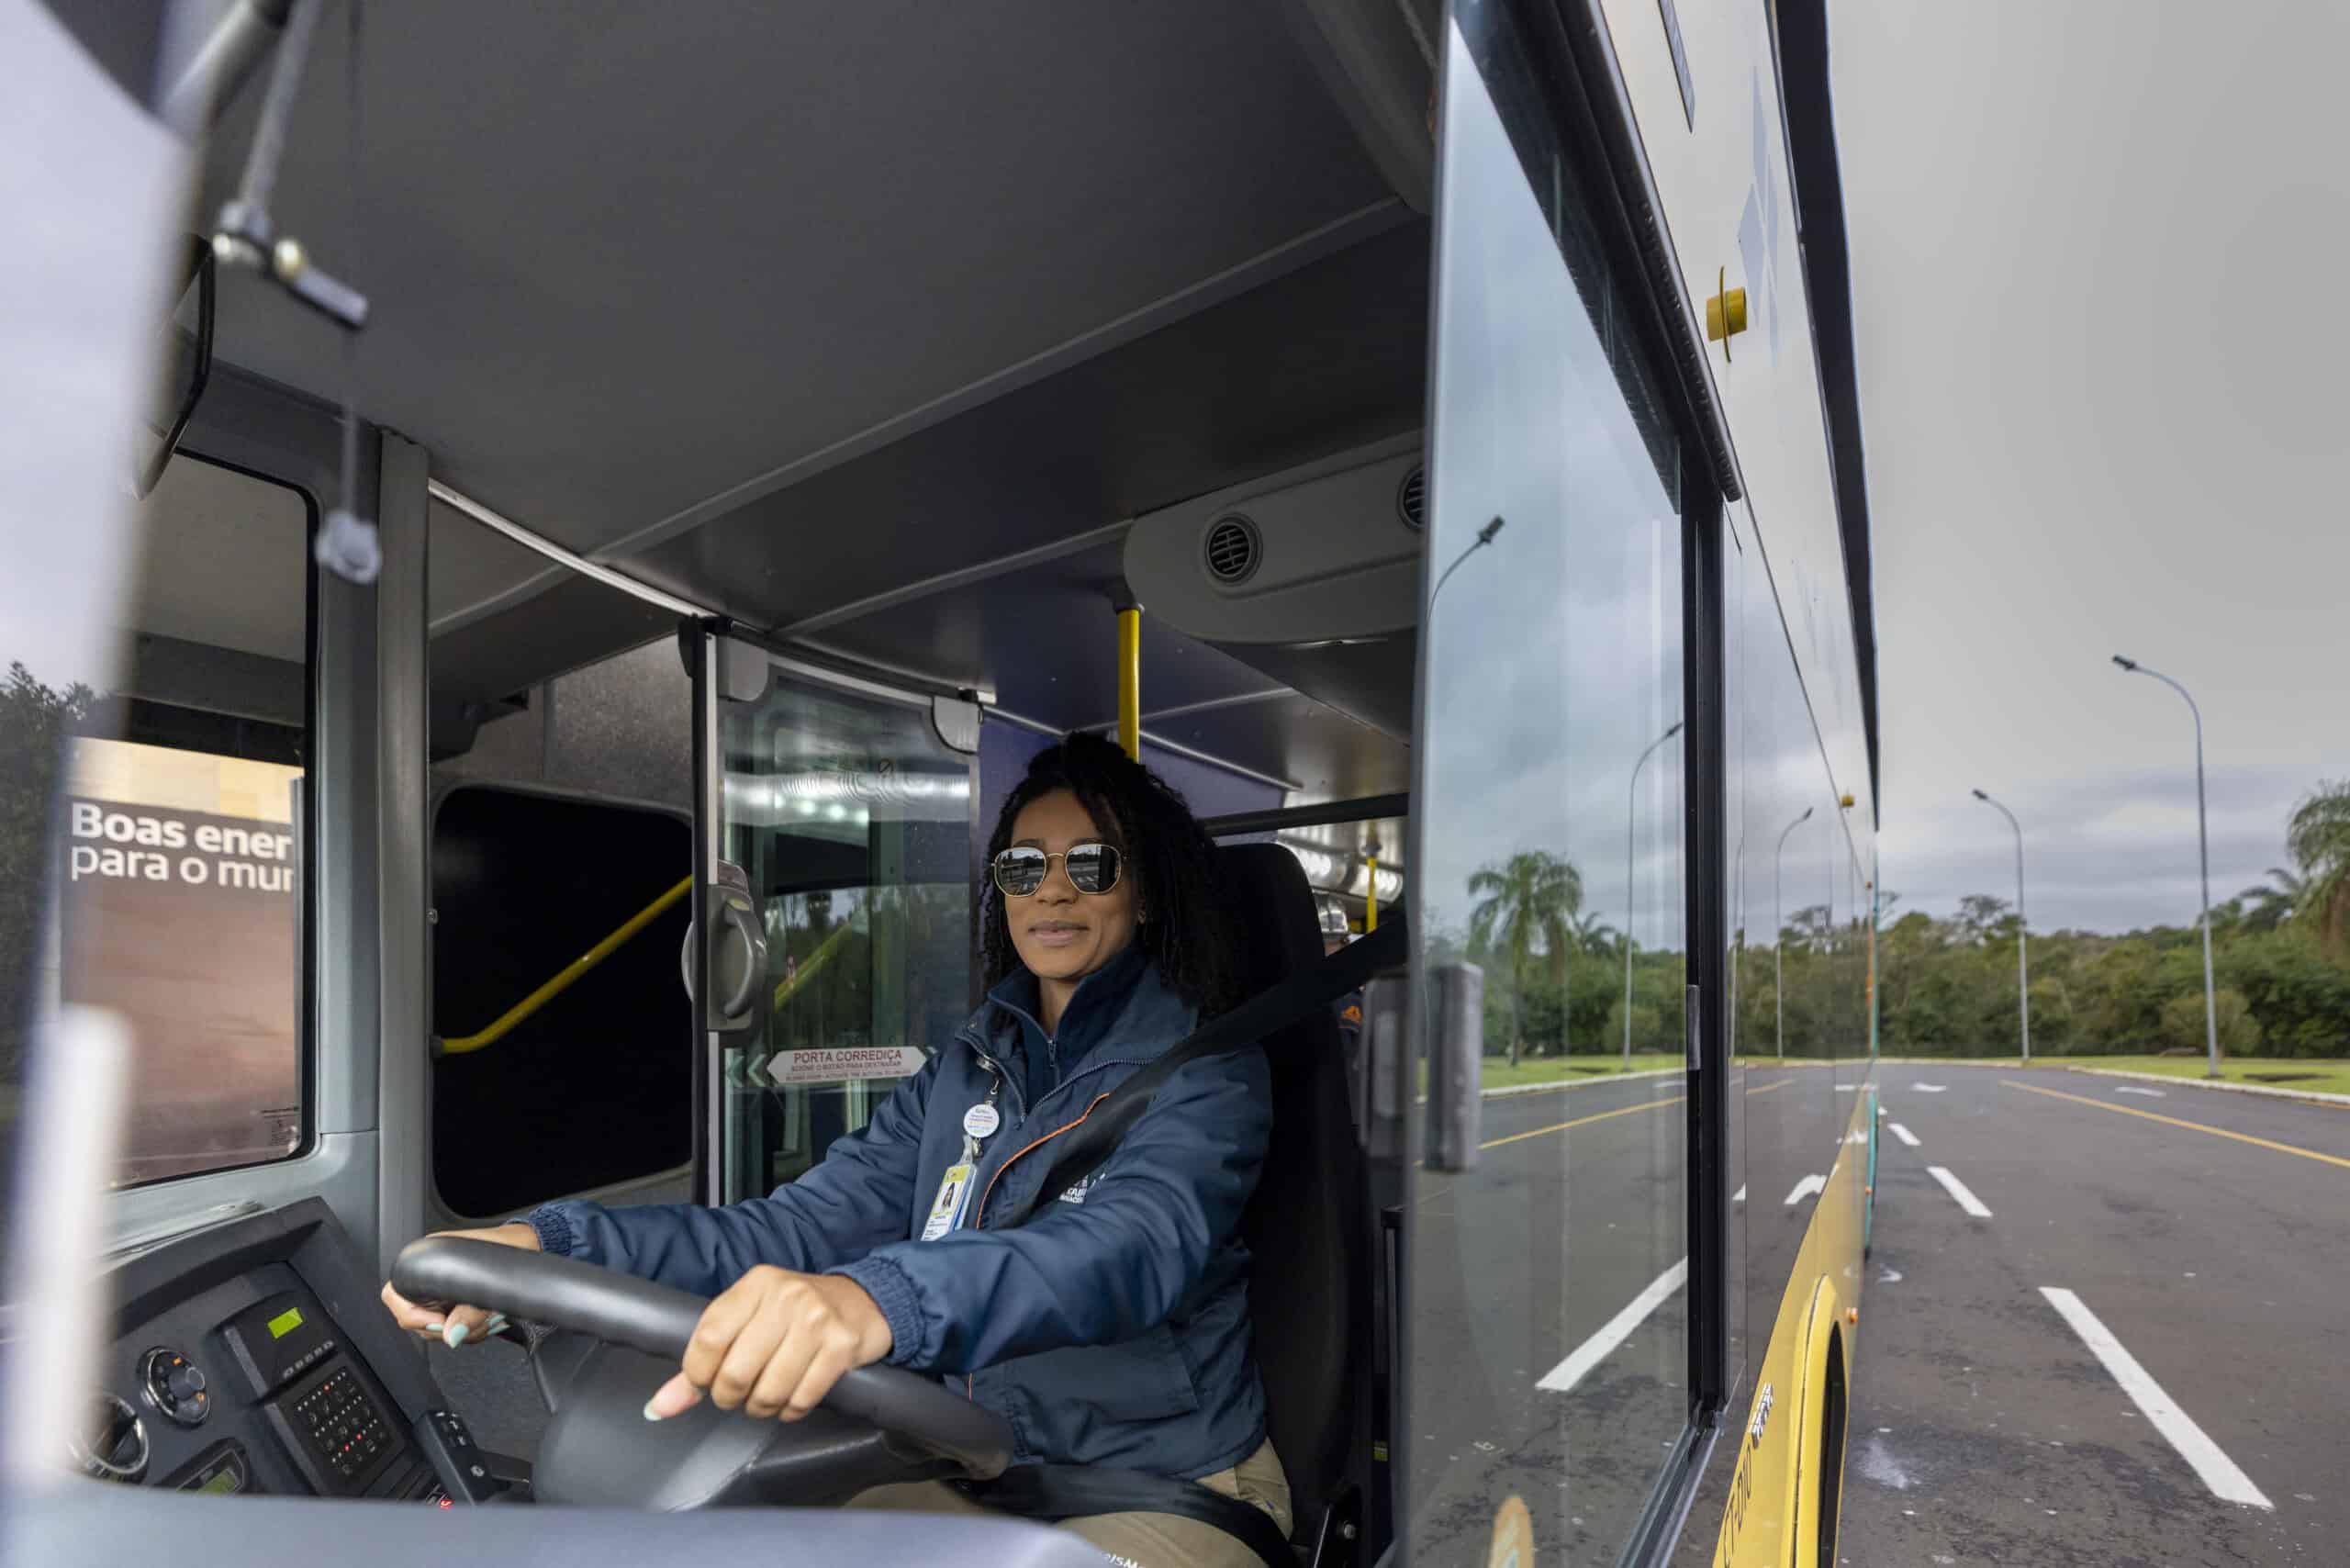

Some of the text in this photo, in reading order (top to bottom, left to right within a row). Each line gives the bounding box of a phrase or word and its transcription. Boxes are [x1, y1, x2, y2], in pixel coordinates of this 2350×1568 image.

[71, 801, 293, 860] Boas ener
[71, 846, 170, 880] para
[179, 856, 209, 884] o
[793, 1049, 902, 1064] PORTA CORREDIÇA
